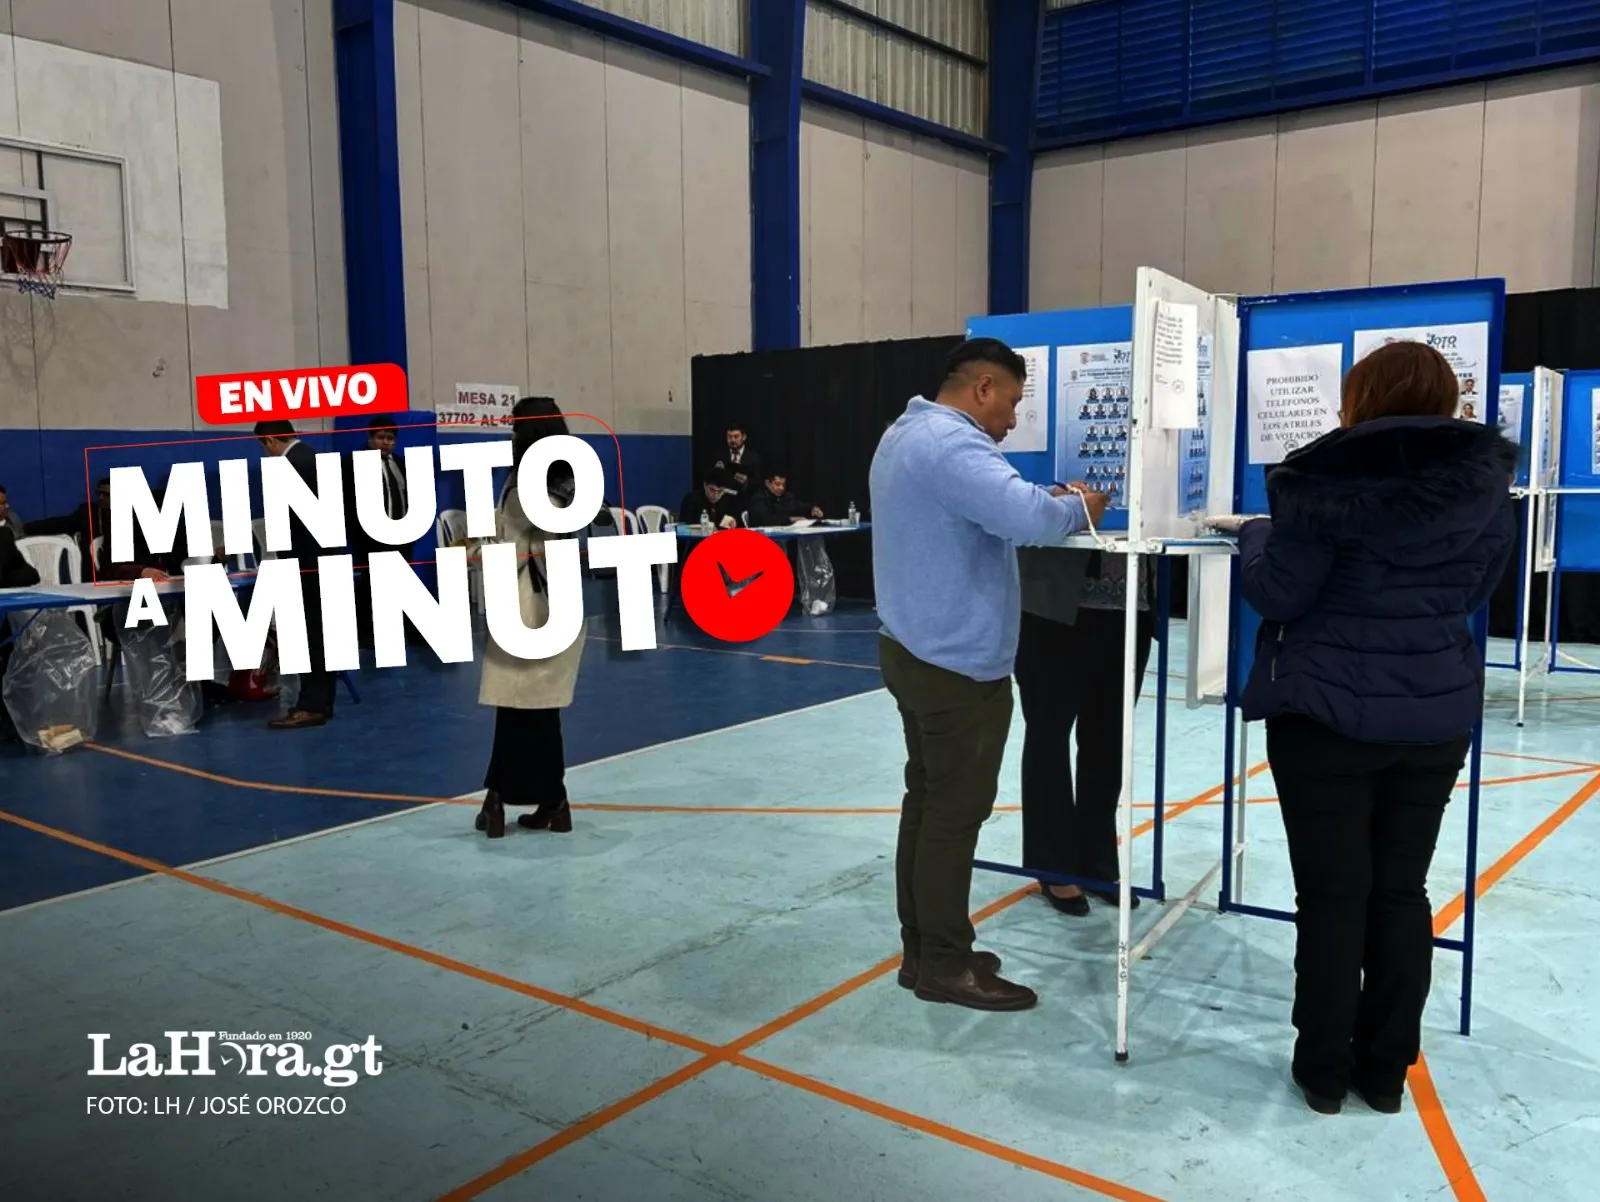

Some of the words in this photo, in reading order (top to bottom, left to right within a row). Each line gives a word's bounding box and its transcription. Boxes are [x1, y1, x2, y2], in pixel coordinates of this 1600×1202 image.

[1266, 374, 1320, 385] PROHIBIDO
[1270, 386, 1314, 397] UTILIZAR
[458, 391, 497, 406] MESA
[501, 394, 516, 407] 21
[1257, 409, 1312, 420] CELULARES
[1314, 407, 1327, 416] EN
[438, 412, 475, 425] 37702
[480, 414, 498, 427] AL
[1263, 423, 1280, 431] LOS
[1283, 420, 1322, 430] ATRILES
[1260, 433, 1273, 442] DE
